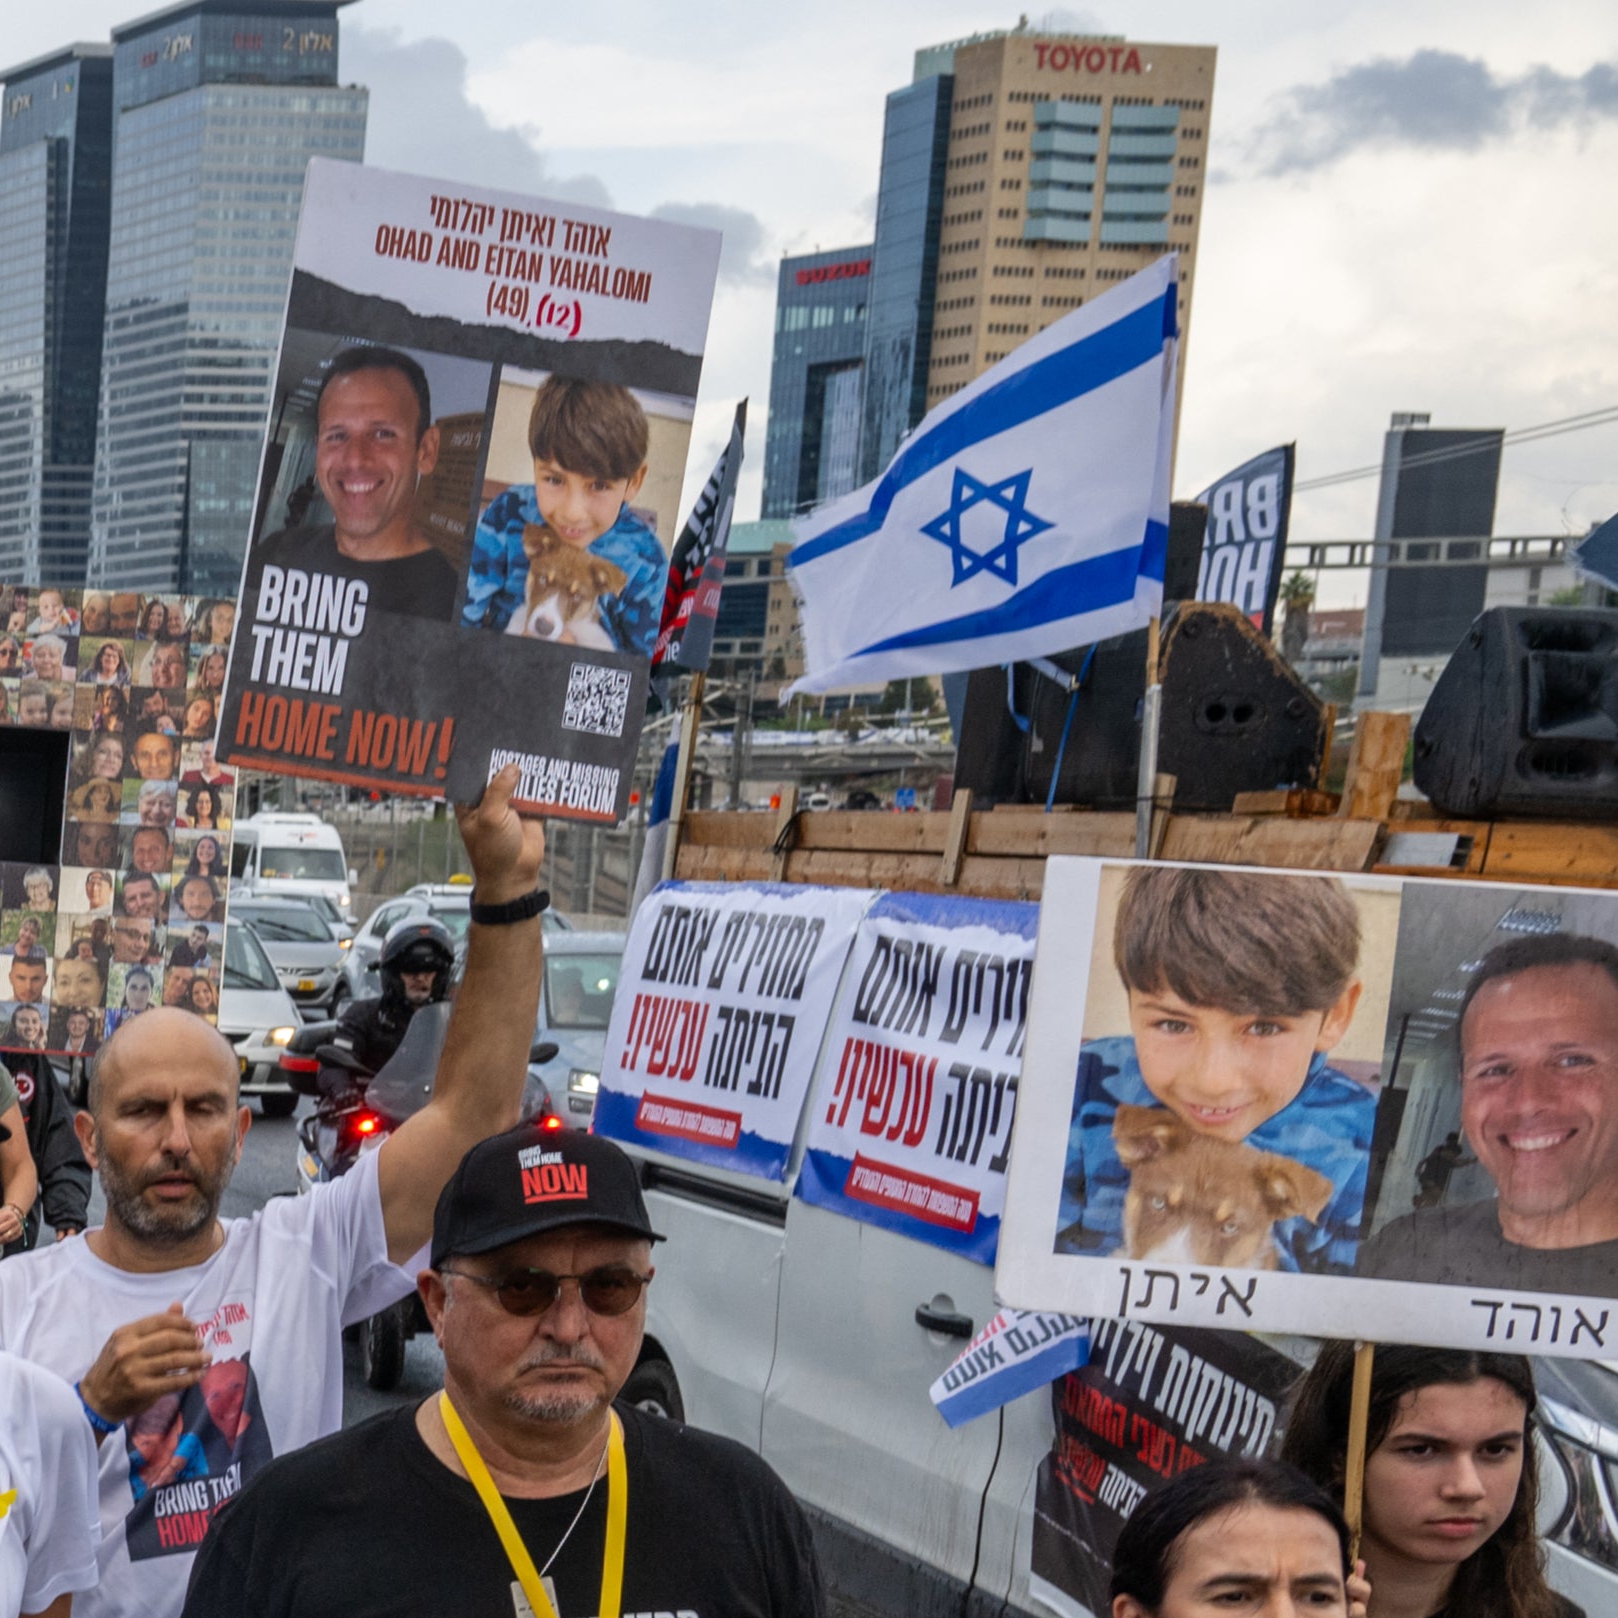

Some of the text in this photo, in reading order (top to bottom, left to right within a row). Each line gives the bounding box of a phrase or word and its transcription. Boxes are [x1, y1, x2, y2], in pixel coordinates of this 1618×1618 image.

[1035, 43, 1142, 74] TOYOTA
[430, 194, 612, 258] אוהד ואיתן יהלומי
[375, 224, 653, 304] OHAD AND EITAN YAHALOMI
[256, 564, 369, 637] BRING
[250, 624, 349, 696] THEM
[235, 690, 455, 780] HOME NOW!
[547, 754, 569, 779] AND
[571, 758, 620, 789] MISSING
[559, 777, 617, 815] FORUM
[641, 904, 826, 1000] מחזירים אותם
[852, 934, 948, 1037] אותם
[620, 993, 796, 1100] הביתה עכשיו!
[825, 1036, 940, 1148] עכשיו!
[521, 1163, 587, 1197] NOW
[1119, 1267, 1258, 1318] איתן
[1471, 1299, 1610, 1347] אוהד
[1155, 1344, 1276, 1460] תינוקות
[154, 1480, 209, 1518] BRING
